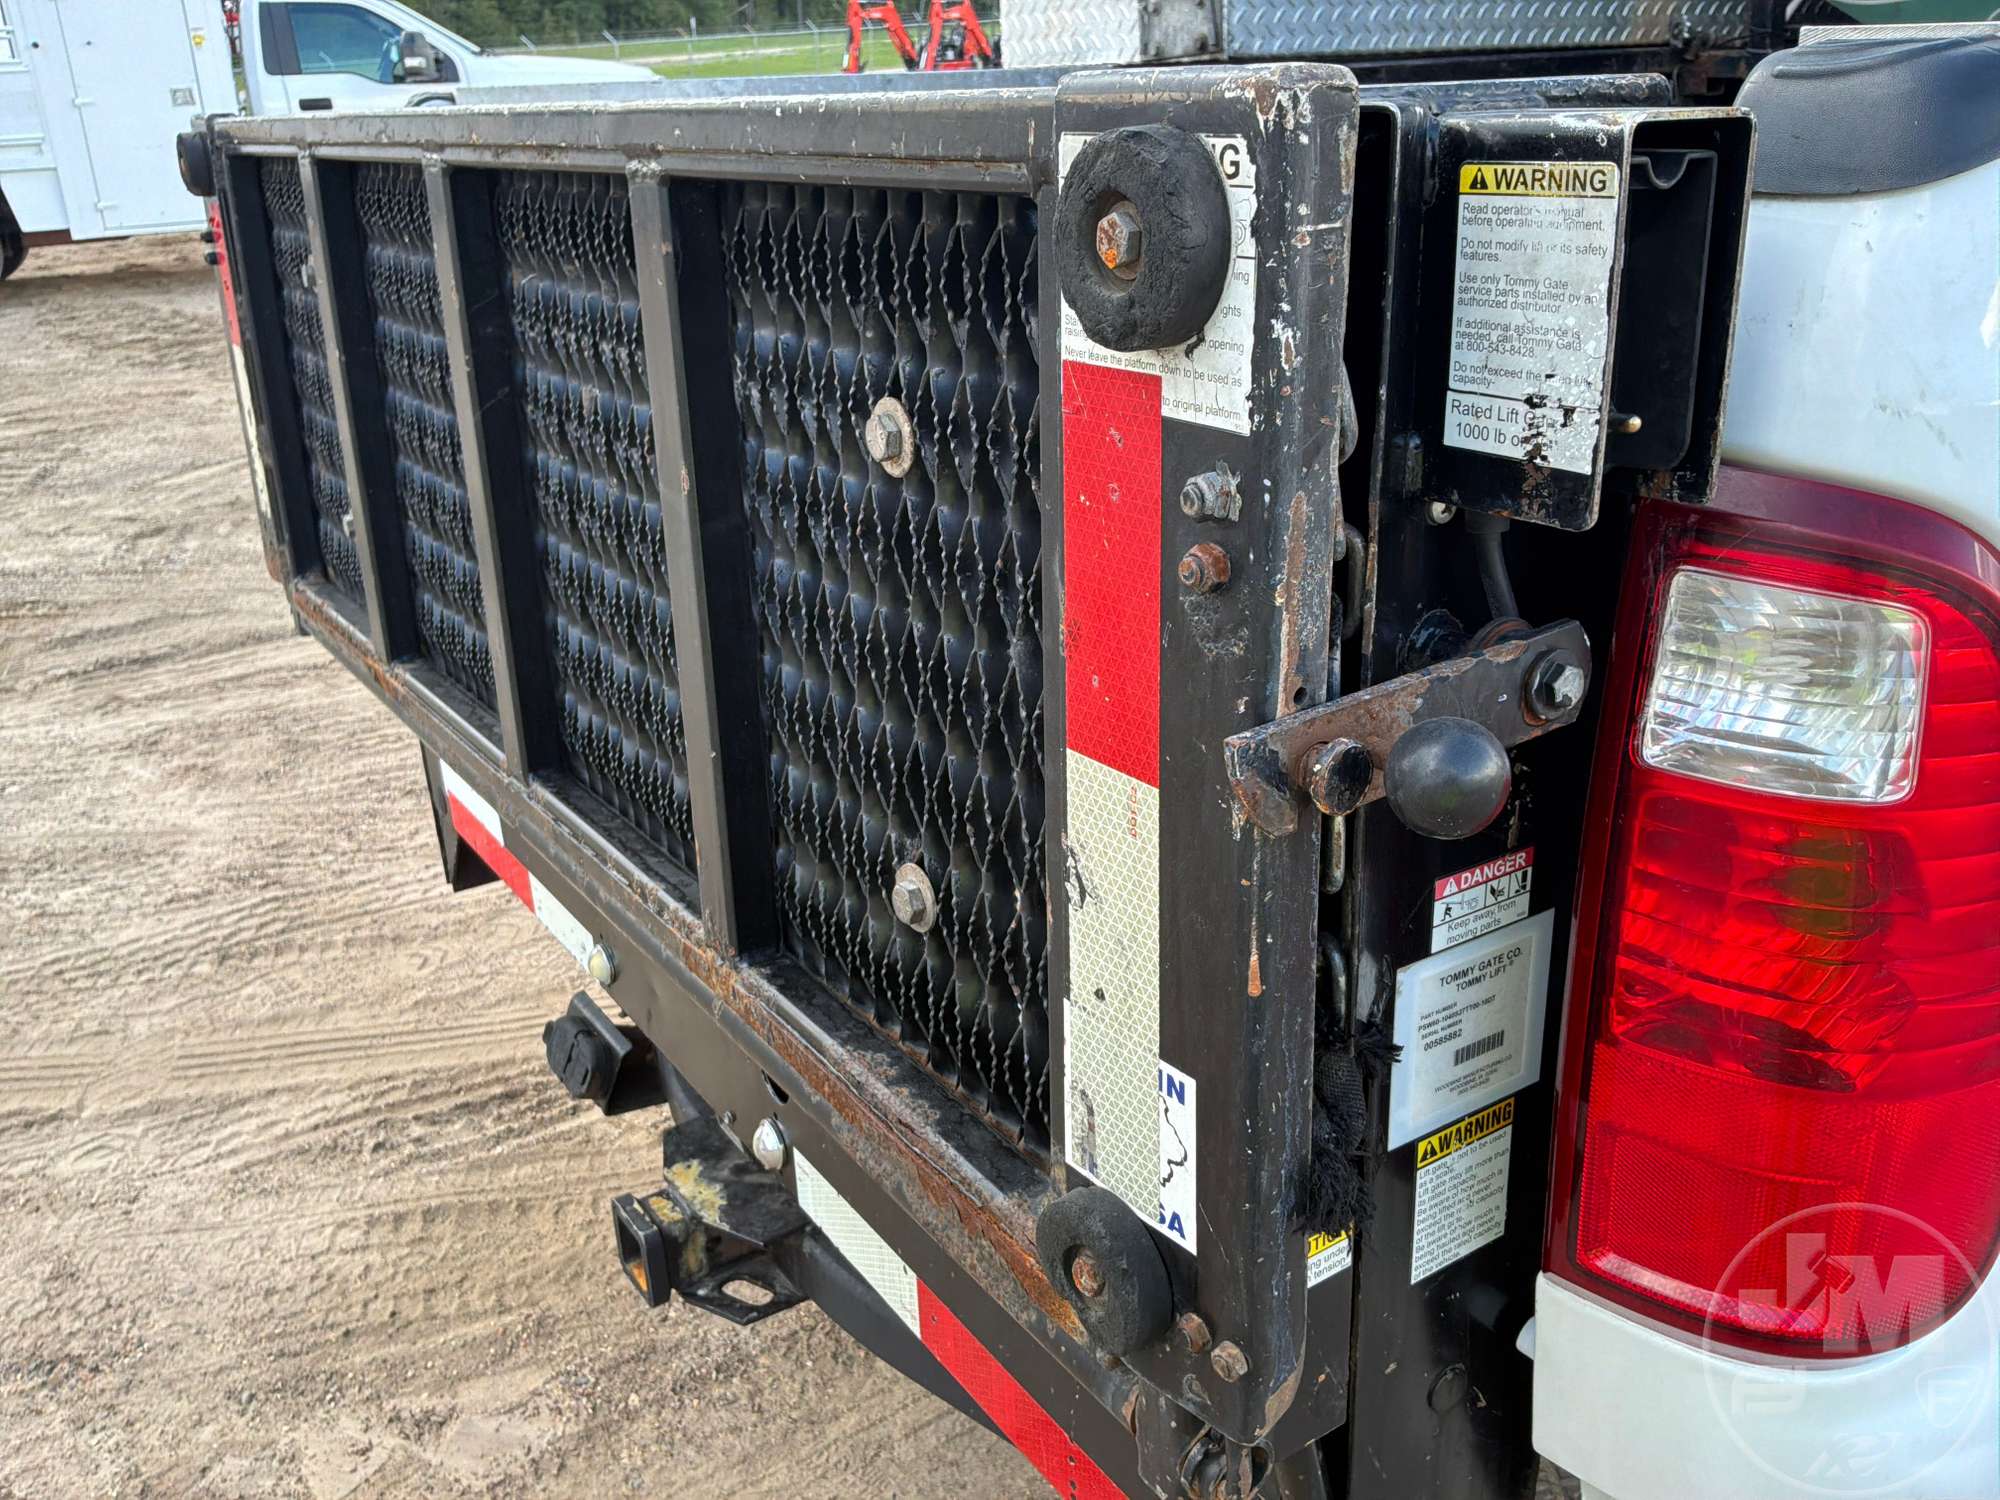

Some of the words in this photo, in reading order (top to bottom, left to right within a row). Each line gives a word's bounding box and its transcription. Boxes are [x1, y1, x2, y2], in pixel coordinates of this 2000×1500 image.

[1493, 168, 1608, 193] WARNING
[1462, 202, 1488, 214] Read
[1462, 214, 1492, 226] before
[1460, 249, 1502, 262] features.
[1461, 237, 1475, 249] Do
[1476, 238, 1493, 250] not
[1495, 239, 1528, 254] modify
[1575, 244, 1608, 258] safety
[1459, 271, 1477, 284] Use
[1480, 273, 1500, 287] only
[1503, 274, 1540, 290] Tommy
[1542, 277, 1569, 290] Gate
[1457, 295, 1507, 309] authorized
[1458, 284, 1490, 296] service
[1494, 286, 1519, 301] parts
[1522, 288, 1565, 301] installed
[1568, 292, 1581, 305] by
[1583, 294, 1597, 303] an
[1456, 317, 1463, 327] If
[1465, 318, 1511, 332] additional
[1514, 323, 1568, 338] assistance
[1571, 328, 1581, 339] is
[1208, 337, 1245, 357] opening
[1455, 340, 1463, 350] at
[1497, 333, 1513, 344] call
[1517, 335, 1553, 350] Tommy
[1110, 352, 1123, 365] the
[1125, 356, 1157, 373] platform
[1159, 361, 1181, 377] down
[1183, 366, 1192, 379] to
[1194, 367, 1205, 381] be
[1207, 371, 1229, 386] used
[1231, 375, 1242, 387] as
[1453, 361, 1467, 372] Do
[1470, 363, 1486, 374] not
[1487, 365, 1523, 379] exceed
[1525, 370, 1541, 381] the
[1163, 394, 1171, 407] to
[1172, 397, 1203, 413] original
[1205, 401, 1241, 421] platform
[1451, 398, 1493, 420] Rated
[1497, 404, 1520, 425] Lift
[1456, 421, 1490, 442] 1000
[1495, 424, 1506, 445] lb
[1460, 853, 1526, 888] DANGER
[1447, 917, 1470, 933] Keep
[1472, 908, 1494, 924] away
[1497, 899, 1516, 911] from
[1446, 927, 1477, 945] moving
[1480, 918, 1501, 931] parts
[1439, 967, 1474, 986] TOMMY
[1478, 955, 1504, 971] GATE
[1456, 973, 1487, 991] TOMMY
[1489, 965, 1507, 977] LIFT
[1437, 1103, 1511, 1153] WARNING
[1419, 1168, 1431, 1179] Lift
[1432, 1160, 1447, 1174] gate
[1456, 1150, 1467, 1160] not
[1469, 1144, 1477, 1153] to
[1478, 1139, 1488, 1148] be
[1489, 1131, 1506, 1143] used
[1418, 1187, 1428, 1197] Lift
[1431, 1180, 1446, 1192] gate
[1474, 1157, 1492, 1168] more
[1418, 1179, 1427, 1187] as
[1416, 1211, 1436, 1226] being
[1438, 1202, 1455, 1214] lifted
[1472, 1184, 1491, 1196] never
[1417, 1206, 1426, 1216] Be
[1428, 1196, 1449, 1210] aware
[1451, 1190, 1458, 1198] of
[1476, 1172, 1495, 1185] much
[1427, 1189, 1445, 1201] rated
[1415, 1243, 1424, 1252] Be
[1426, 1233, 1447, 1247] aware
[1449, 1227, 1456, 1235] of
[1474, 1208, 1493, 1221] much
[1416, 1218, 1441, 1234] exceed
[1443, 1210, 1455, 1220] the
[1415, 1248, 1434, 1263] being
[1436, 1234, 1460, 1250] hauled
[1476, 1217, 1495, 1229] never
[1416, 1235, 1423, 1244] of
[1424, 1229, 1435, 1239] the
[1314, 1257, 1346, 1280] tension
[1414, 1254, 1439, 1271] exceed
[1441, 1246, 1452, 1256] the
